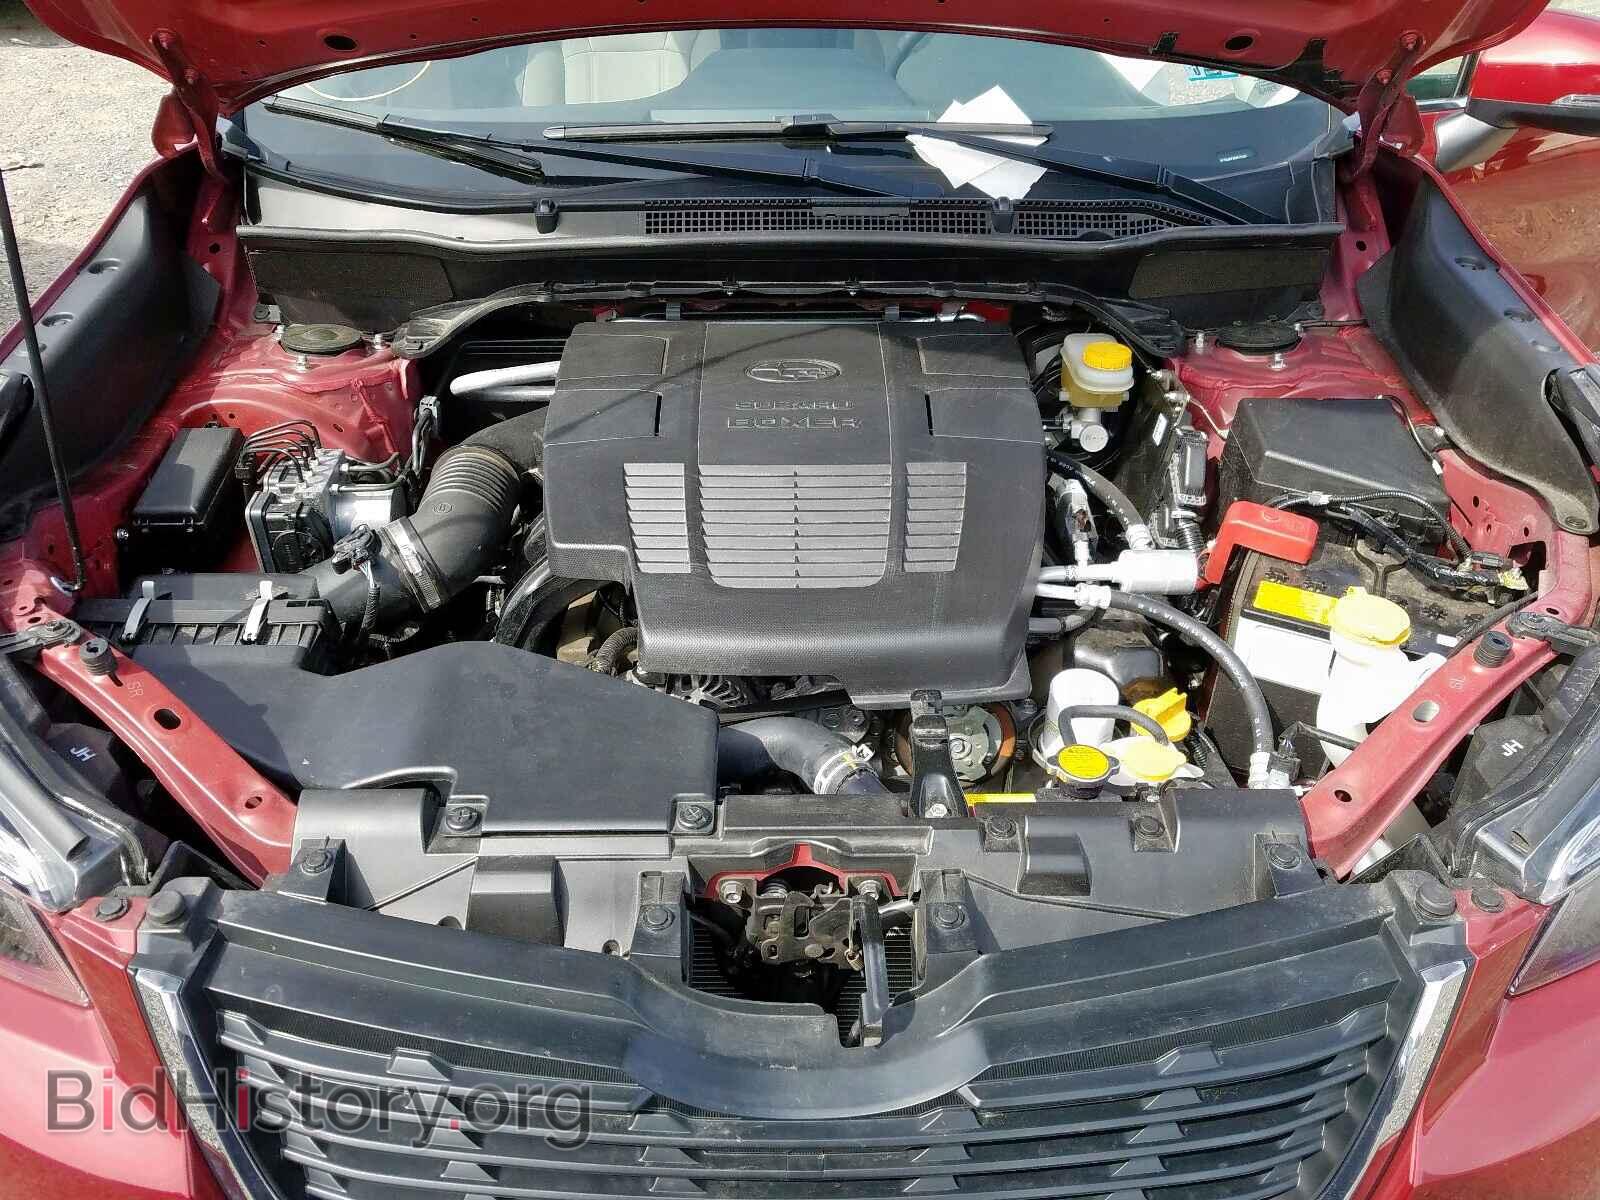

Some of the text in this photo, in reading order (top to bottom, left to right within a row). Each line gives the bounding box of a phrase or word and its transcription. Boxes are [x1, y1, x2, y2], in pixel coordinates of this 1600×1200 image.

[735, 399, 854, 411] SUBARU
[727, 416, 863, 429] BOXER
[70, 747, 96, 762] JH
[1502, 739, 1524, 757] JH
